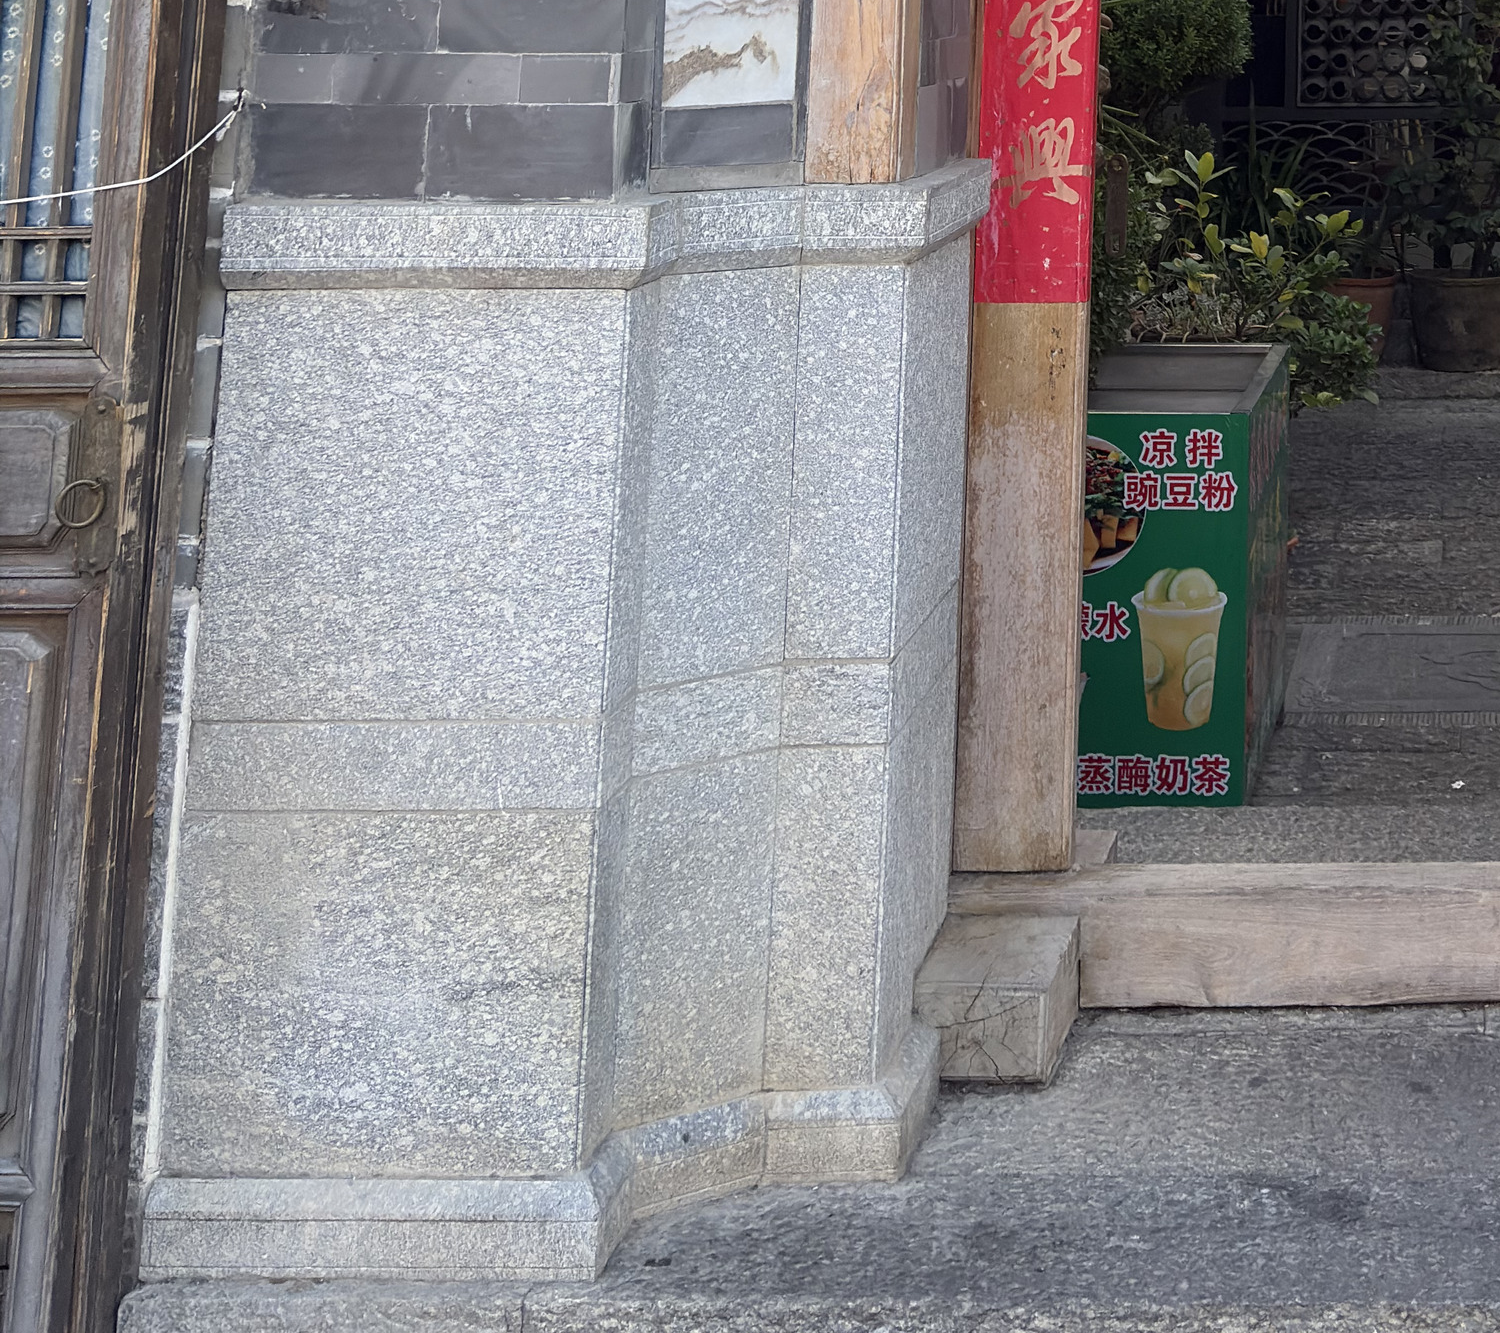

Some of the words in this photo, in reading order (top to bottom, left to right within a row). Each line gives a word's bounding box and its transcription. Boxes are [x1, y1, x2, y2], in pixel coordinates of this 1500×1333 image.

[1139, 429, 1223, 469] 凉拌
[1123, 471, 1238, 512] 豌豆粉
[1077, 753, 1231, 796] 蒸酶奶茶
